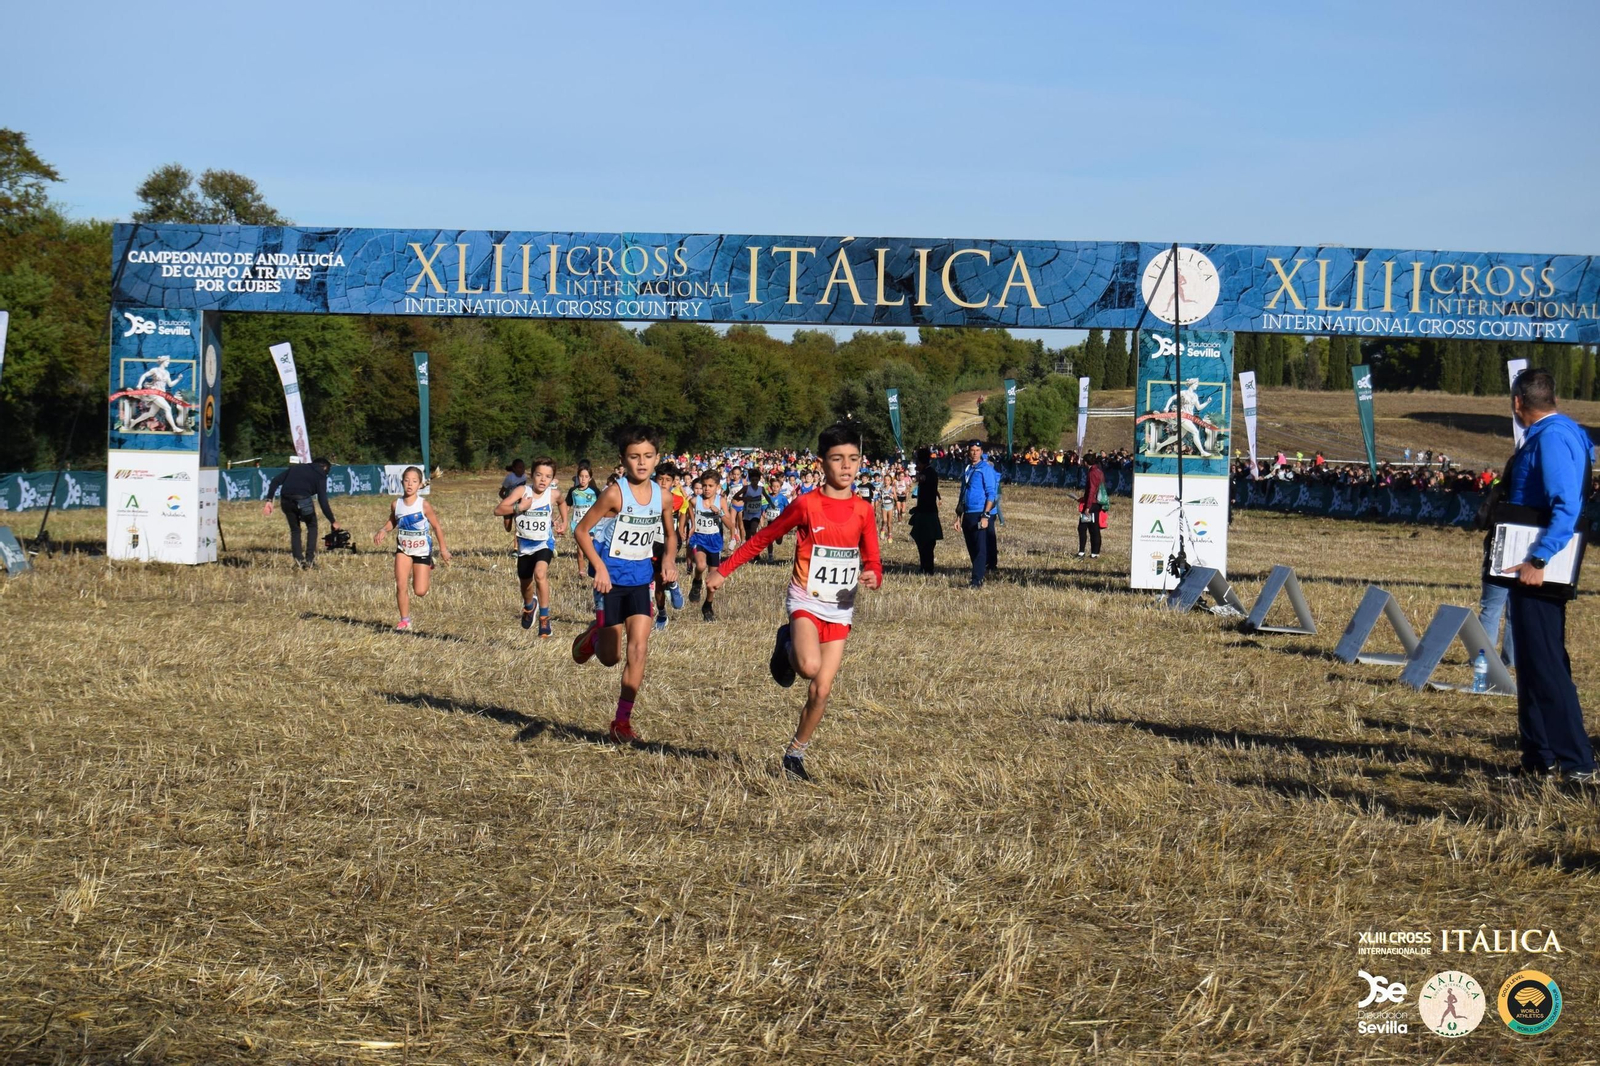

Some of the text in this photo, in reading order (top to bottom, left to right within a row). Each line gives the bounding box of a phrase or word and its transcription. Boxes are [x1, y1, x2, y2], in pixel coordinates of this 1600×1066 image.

[128, 251, 345, 267] CAMPEONATO DE ANDALUCÍA
[406, 242, 561, 295] XLIII
[566, 245, 688, 277] CROSS
[162, 265, 312, 280] DE CAMPO A TRAVÉS
[745, 236, 1046, 309] ITÁLICA
[1430, 264, 1555, 298] CROSS
[196, 280, 280, 292] POR CLUBES
[566, 279, 733, 298] INTERNACIONAL
[1263, 258, 1424, 313] XLIII
[405, 298, 702, 317] INTERNATIONAL CROSS COUNTRY
[1429, 298, 1600, 320] INTERNACIONAL
[158, 326, 190, 336] Sevilla
[1263, 314, 1570, 339] INTERNATIONAL CROSS COUNTRY
[1187, 348, 1220, 358] Sevilla
[519, 520, 546, 531] 4198
[402, 540, 425, 548] 4369
[618, 530, 654, 546] 4200
[814, 566, 856, 585] 4117
